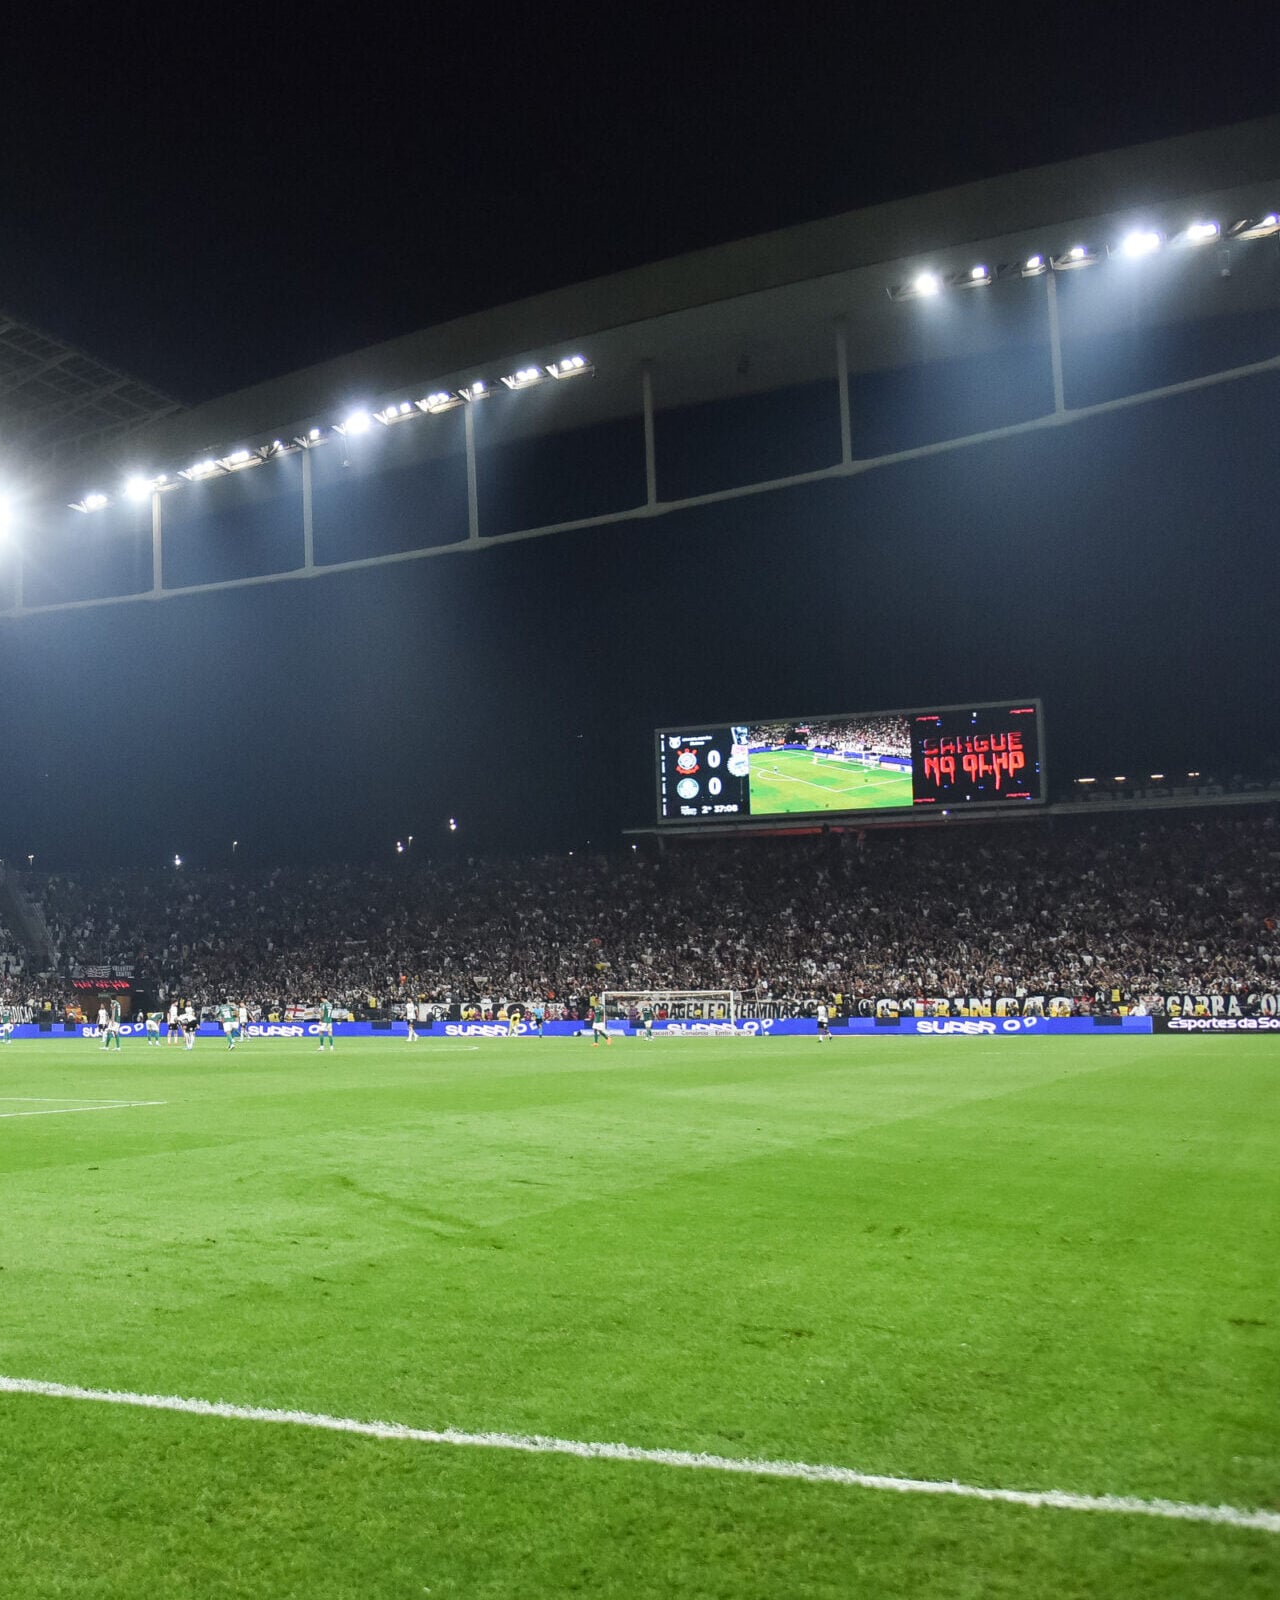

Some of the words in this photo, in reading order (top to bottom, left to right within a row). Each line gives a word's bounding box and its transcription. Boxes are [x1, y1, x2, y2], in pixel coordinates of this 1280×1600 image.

[707, 750, 721, 768] 0
[708, 777, 722, 795] 0
[247, 1025, 304, 1037] SUPER
[445, 1024, 509, 1037] SUPER
[916, 1020, 997, 1035] SUPER
[1167, 1017, 1236, 1031] Esportes
[1237, 1017, 1258, 1030] da
[1257, 1017, 1280, 1030] So
